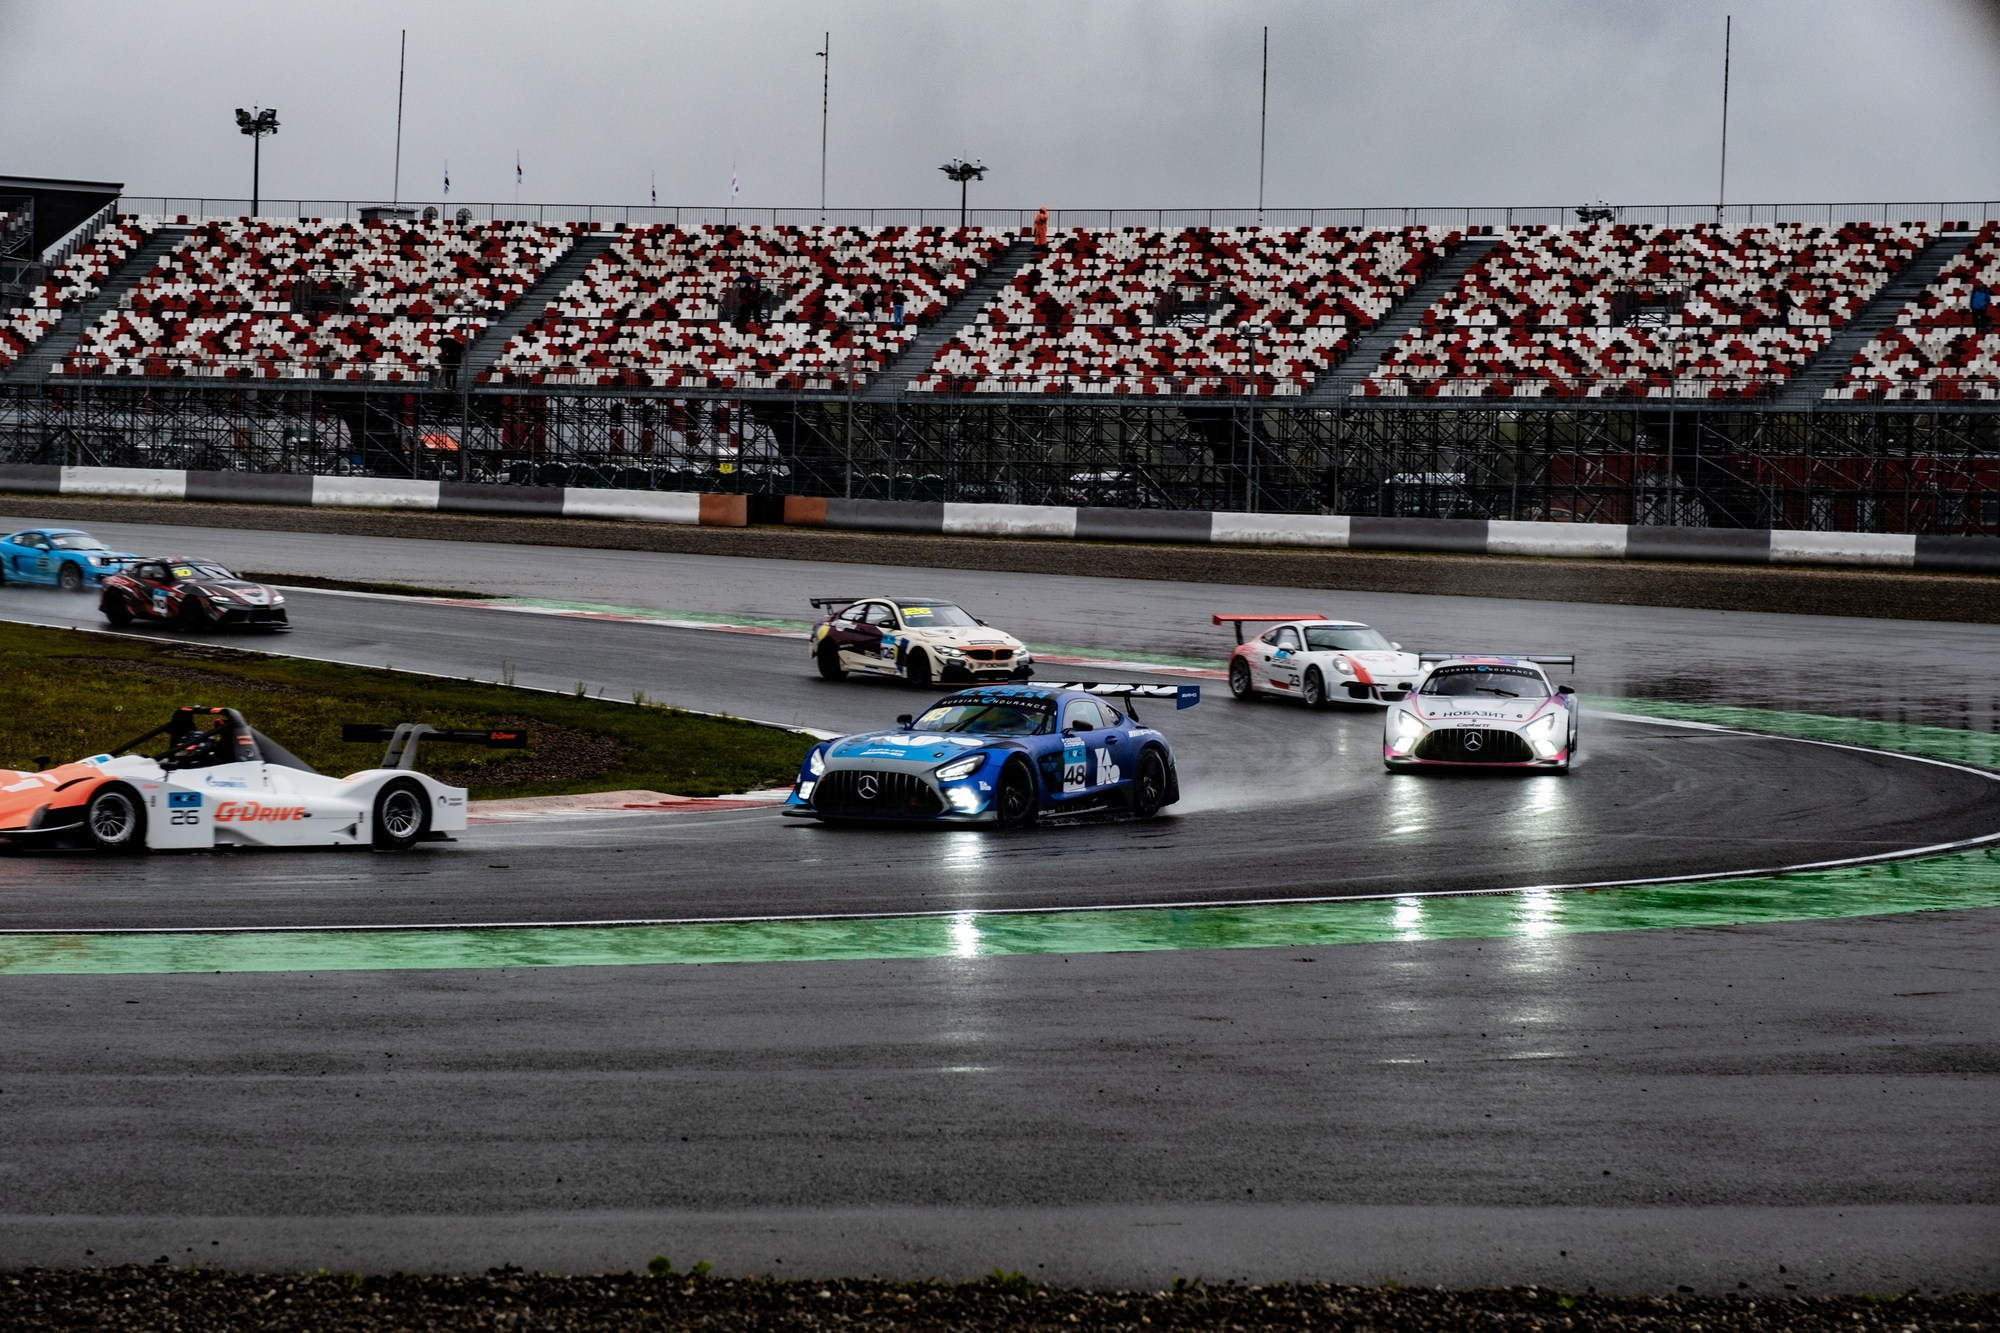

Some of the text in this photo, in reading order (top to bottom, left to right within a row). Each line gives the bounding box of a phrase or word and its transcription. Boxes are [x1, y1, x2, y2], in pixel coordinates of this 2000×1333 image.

[1288, 673, 1301, 687] 23
[1443, 710, 1507, 719] НОБАЗИТ
[1064, 764, 1085, 786] 48
[170, 810, 200, 826] 26
